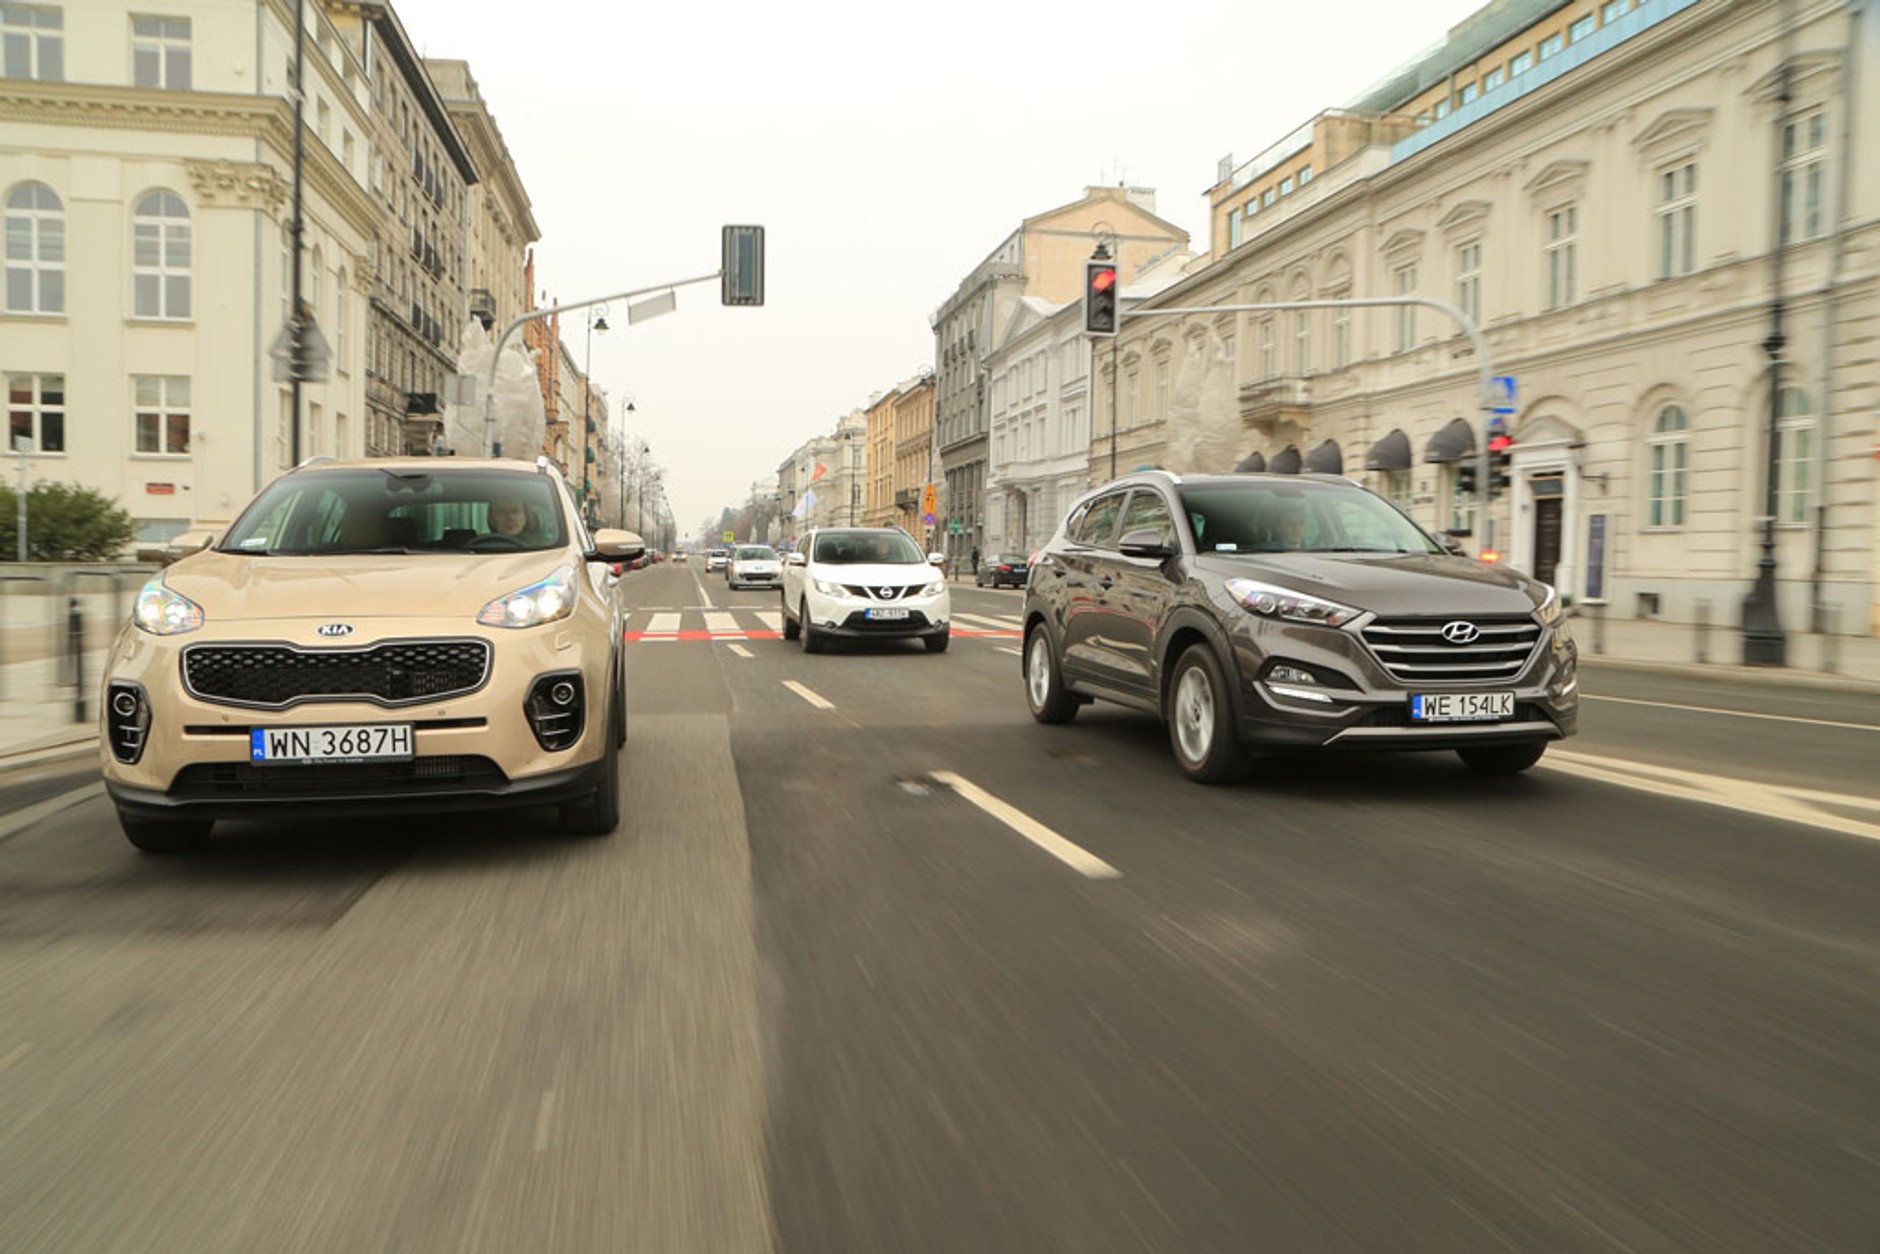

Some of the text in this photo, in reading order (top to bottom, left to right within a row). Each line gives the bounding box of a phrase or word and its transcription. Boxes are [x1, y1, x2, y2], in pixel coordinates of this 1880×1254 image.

[321, 625, 349, 635] KIA
[1424, 694, 1511, 716] WE 154LK
[270, 727, 408, 757] WN 3687H
